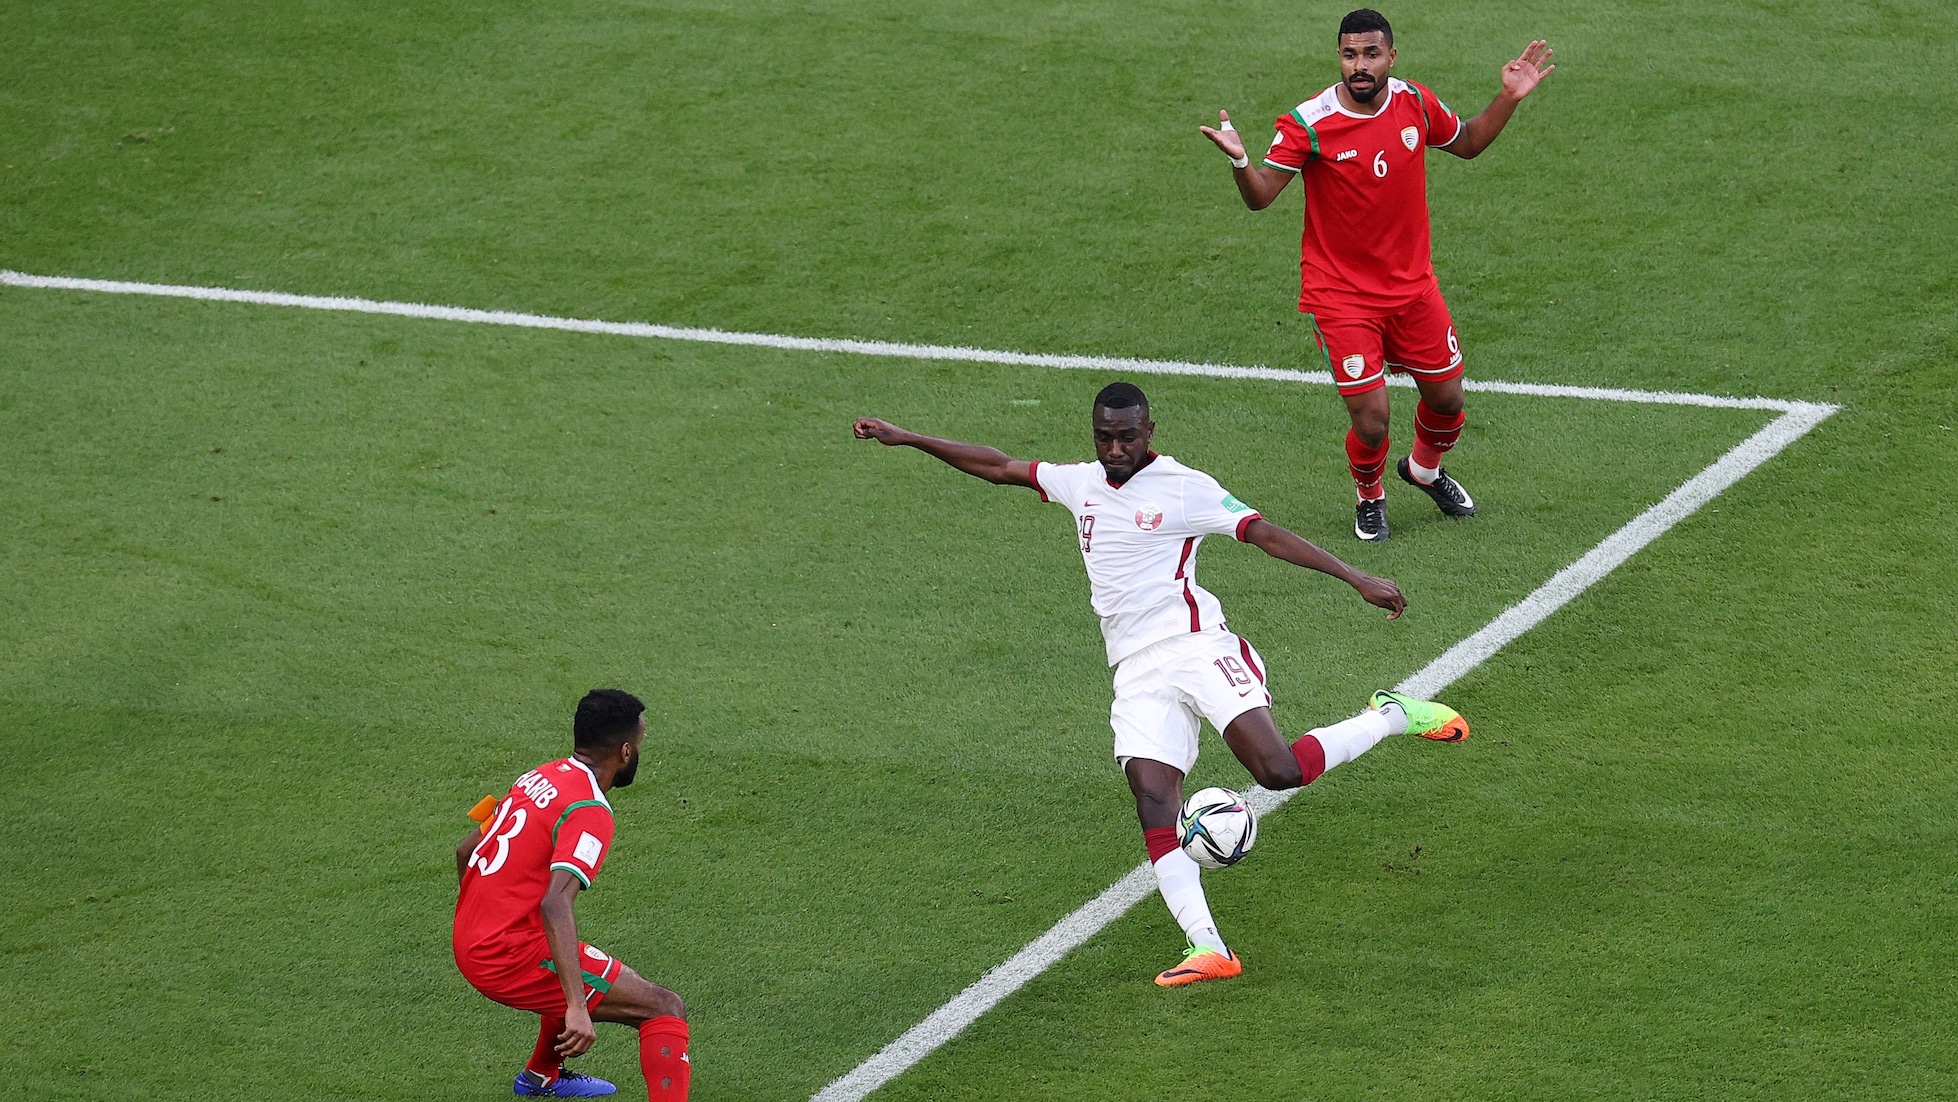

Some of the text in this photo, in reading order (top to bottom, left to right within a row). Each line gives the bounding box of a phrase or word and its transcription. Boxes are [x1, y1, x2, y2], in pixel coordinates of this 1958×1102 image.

[1337, 150, 1358, 161] JAKO
[1374, 150, 1388, 178] 6
[1447, 326, 1458, 353] 6
[1079, 515, 1095, 553] 19
[1213, 656, 1251, 687] 19
[514, 769, 559, 809] HARIB
